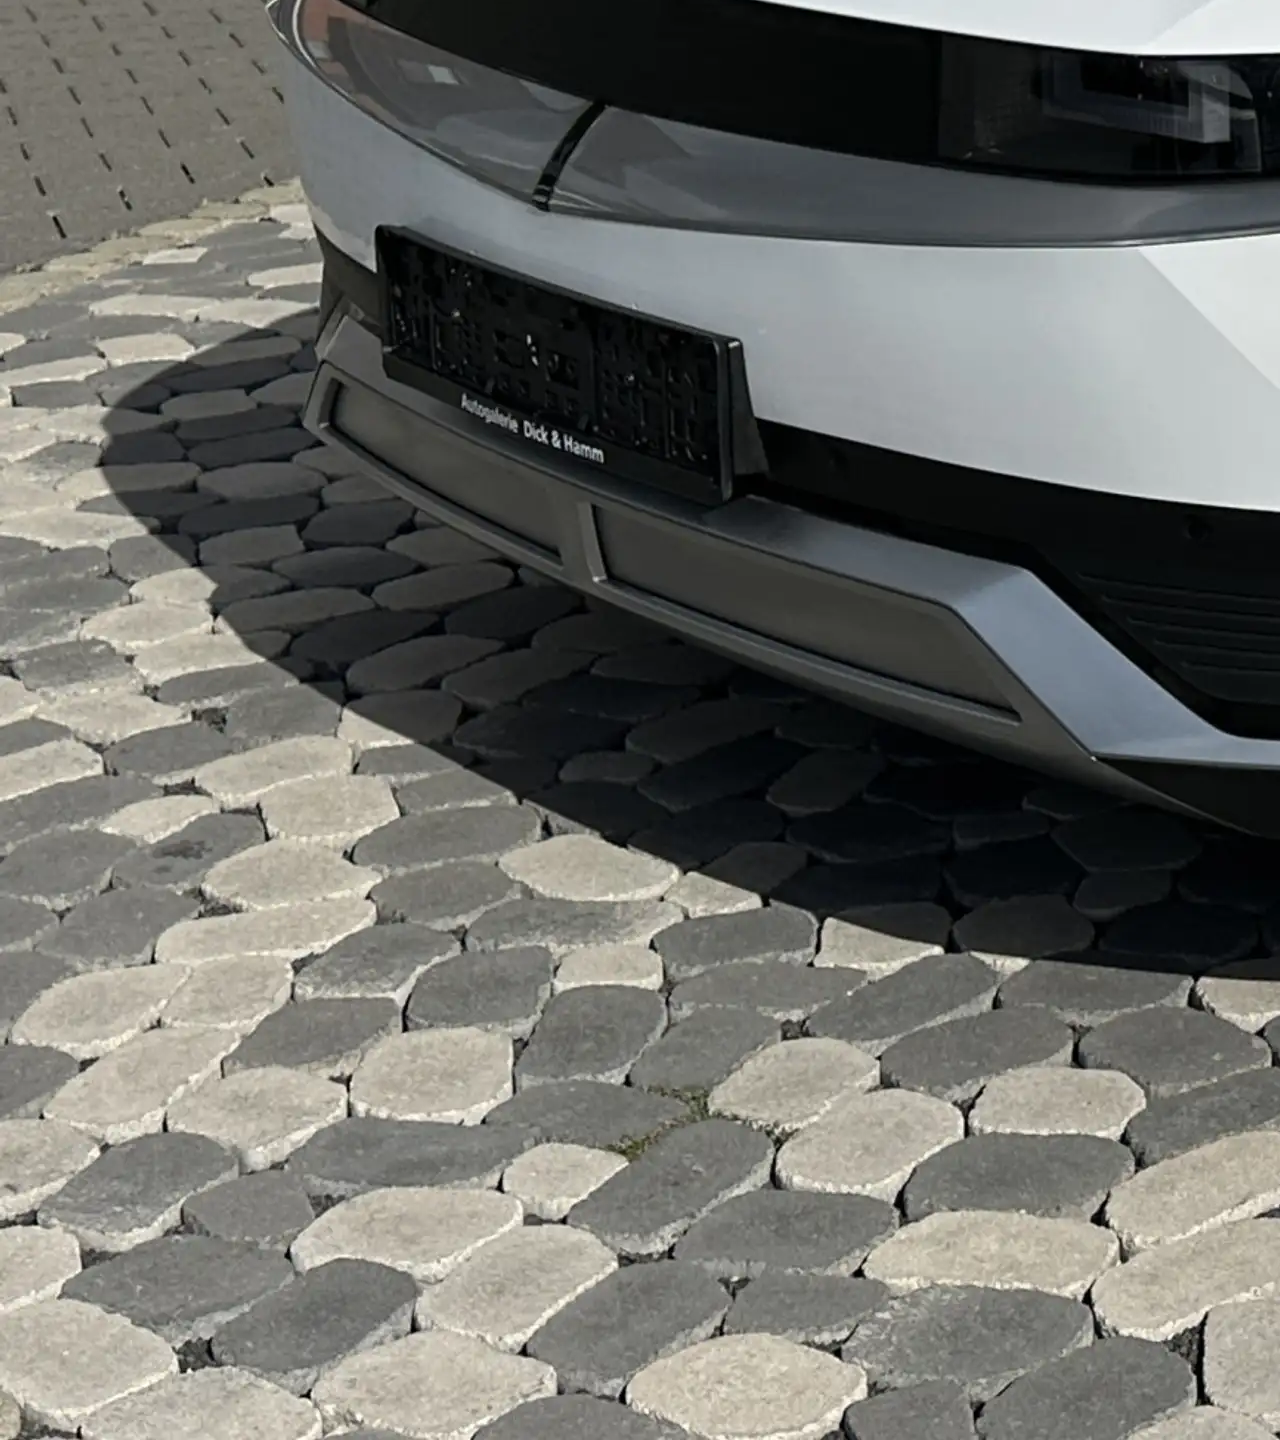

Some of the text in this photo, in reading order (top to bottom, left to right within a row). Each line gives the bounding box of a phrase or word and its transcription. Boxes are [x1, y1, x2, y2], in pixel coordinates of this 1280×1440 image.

[461, 392, 605, 464] Autogalerie Dick & Hamm
